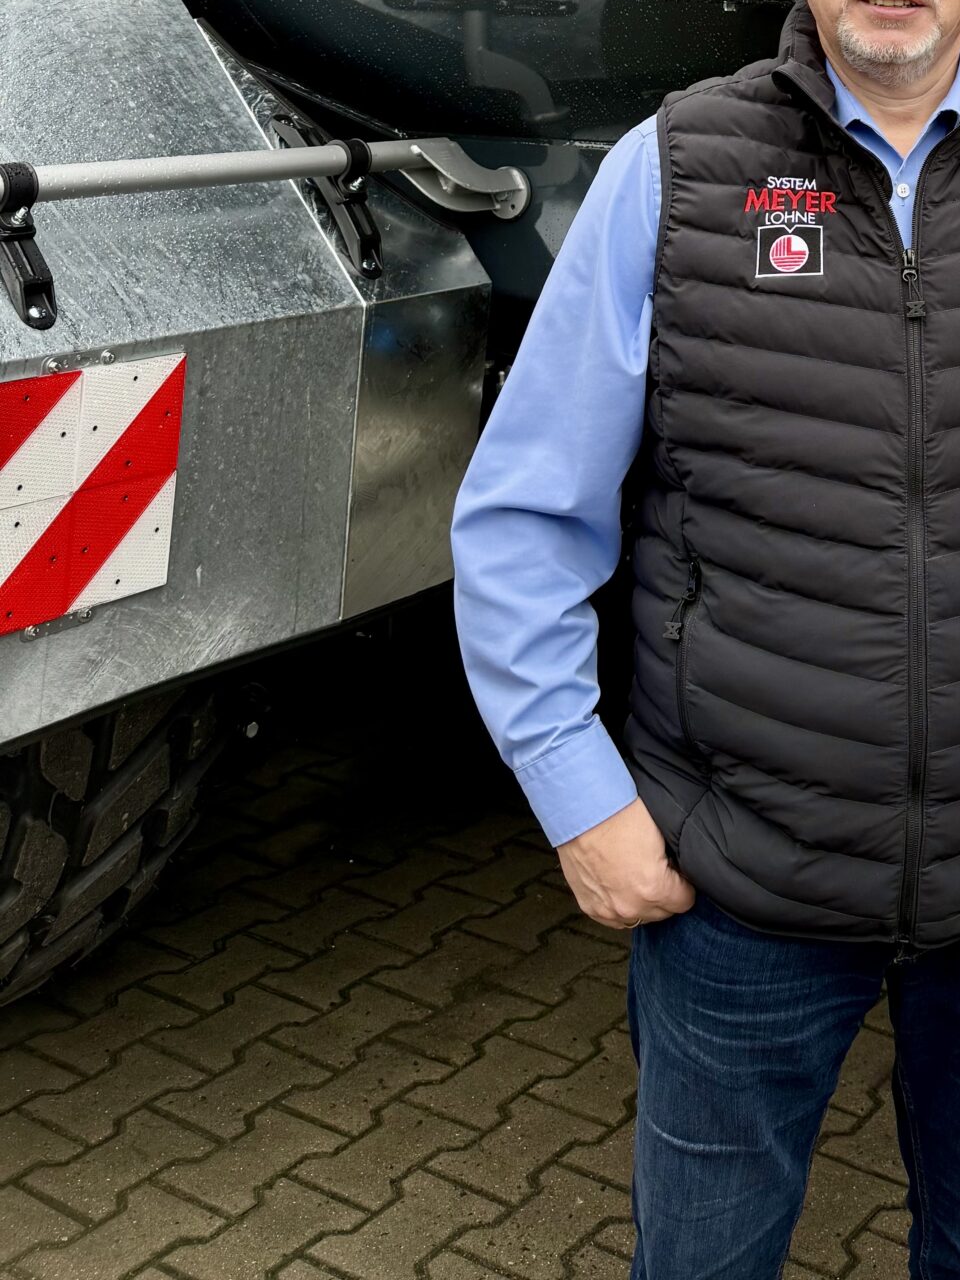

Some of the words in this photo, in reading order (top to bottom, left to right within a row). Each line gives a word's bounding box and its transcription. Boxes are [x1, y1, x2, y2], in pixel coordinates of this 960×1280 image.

[767, 176, 817, 190] SYSTEM
[744, 188, 837, 213] MEYER
[765, 211, 816, 225] LOHNE
